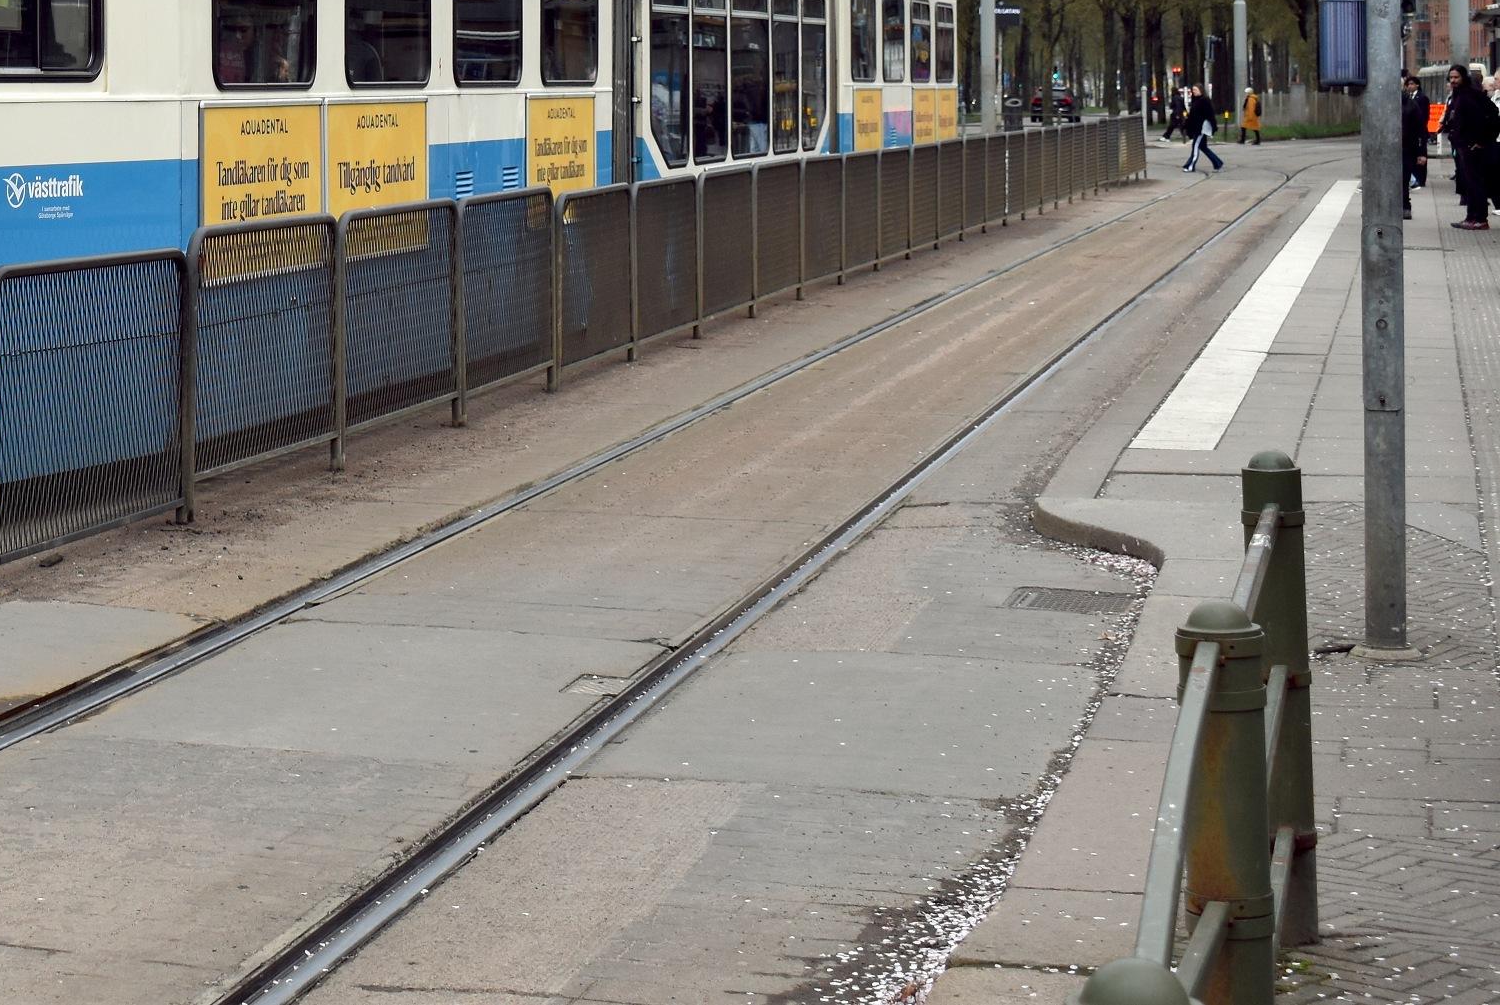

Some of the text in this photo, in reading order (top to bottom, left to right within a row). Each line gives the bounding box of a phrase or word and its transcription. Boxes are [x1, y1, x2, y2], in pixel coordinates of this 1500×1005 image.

[240, 118, 288, 136] AQUADENTAL
[356, 113, 399, 130] AQUADENTAL
[216, 156, 309, 186] Tandläkaren för dig som
[338, 156, 415, 196] Tillgänglig tandvård
[27, 174, 84, 199] västtrafik
[221, 190, 306, 222] inte gillar tandläkaren
